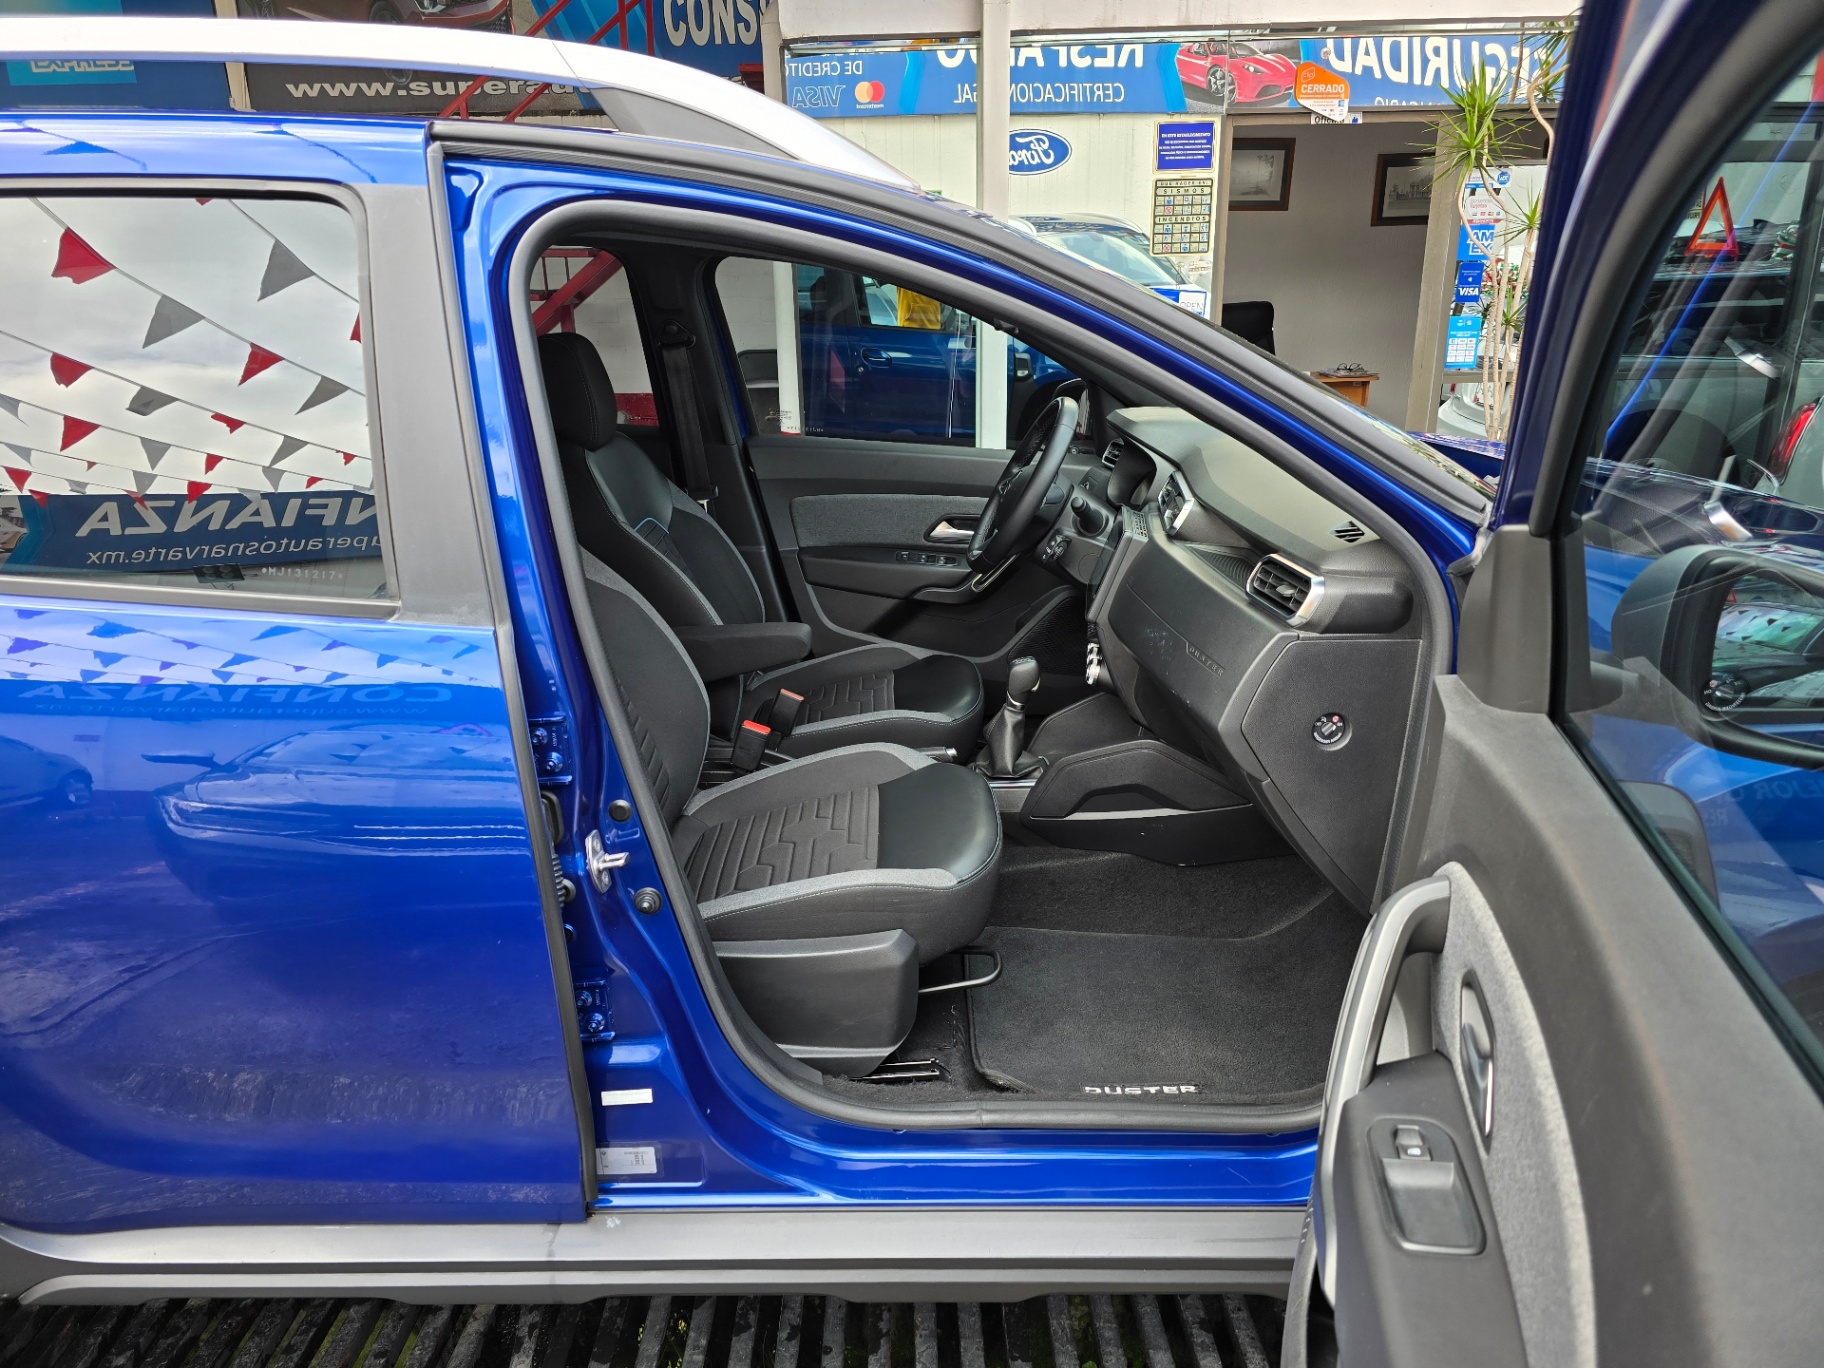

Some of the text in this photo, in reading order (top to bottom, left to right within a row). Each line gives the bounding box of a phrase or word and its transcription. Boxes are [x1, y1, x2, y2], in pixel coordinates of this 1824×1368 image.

[663, 0, 764, 46] CONS
[1301, 83, 1345, 93] CERRADO
[1457, 287, 1479, 296] VISA
